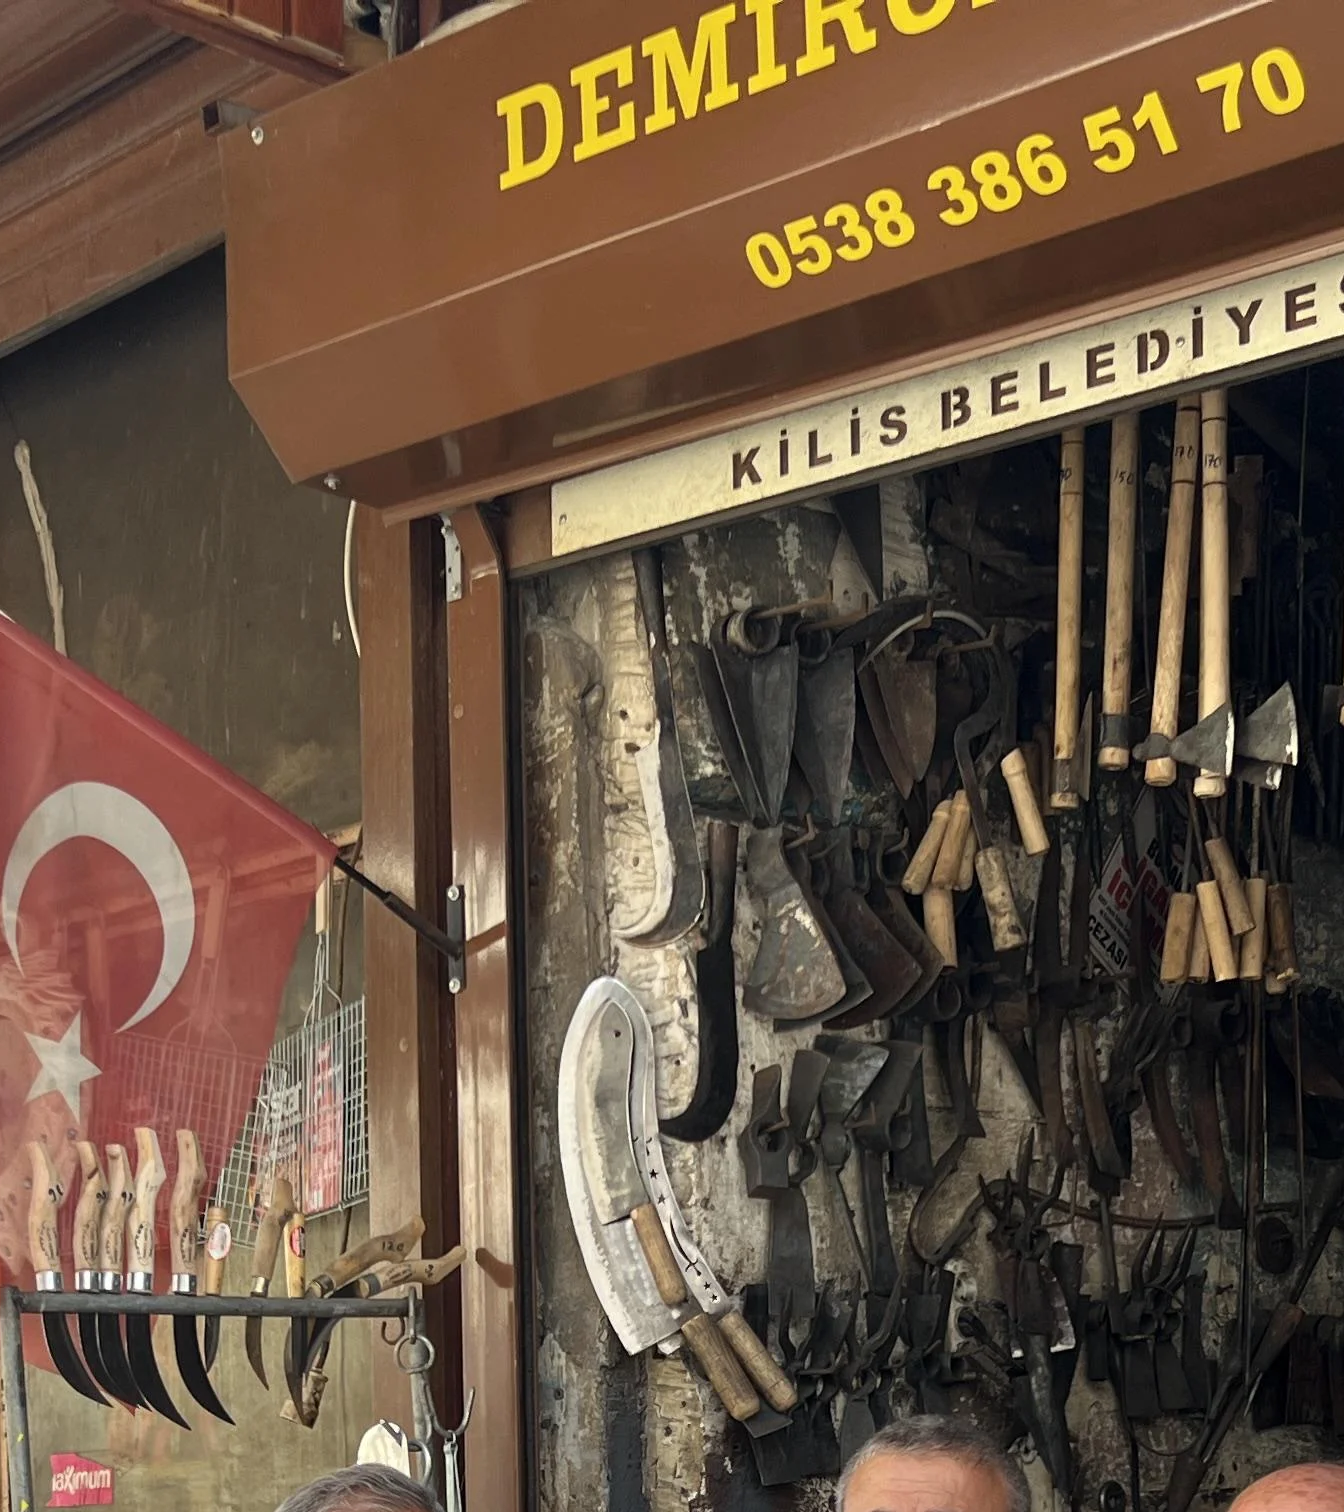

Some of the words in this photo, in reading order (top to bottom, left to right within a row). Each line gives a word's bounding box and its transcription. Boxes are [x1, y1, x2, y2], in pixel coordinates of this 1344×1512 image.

[746, 187, 916, 289] 0538
[928, 132, 1068, 226] 386
[1084, 90, 1179, 173] 51
[1198, 47, 1306, 133] 70
[732, 405, 908, 490] KİLİS
